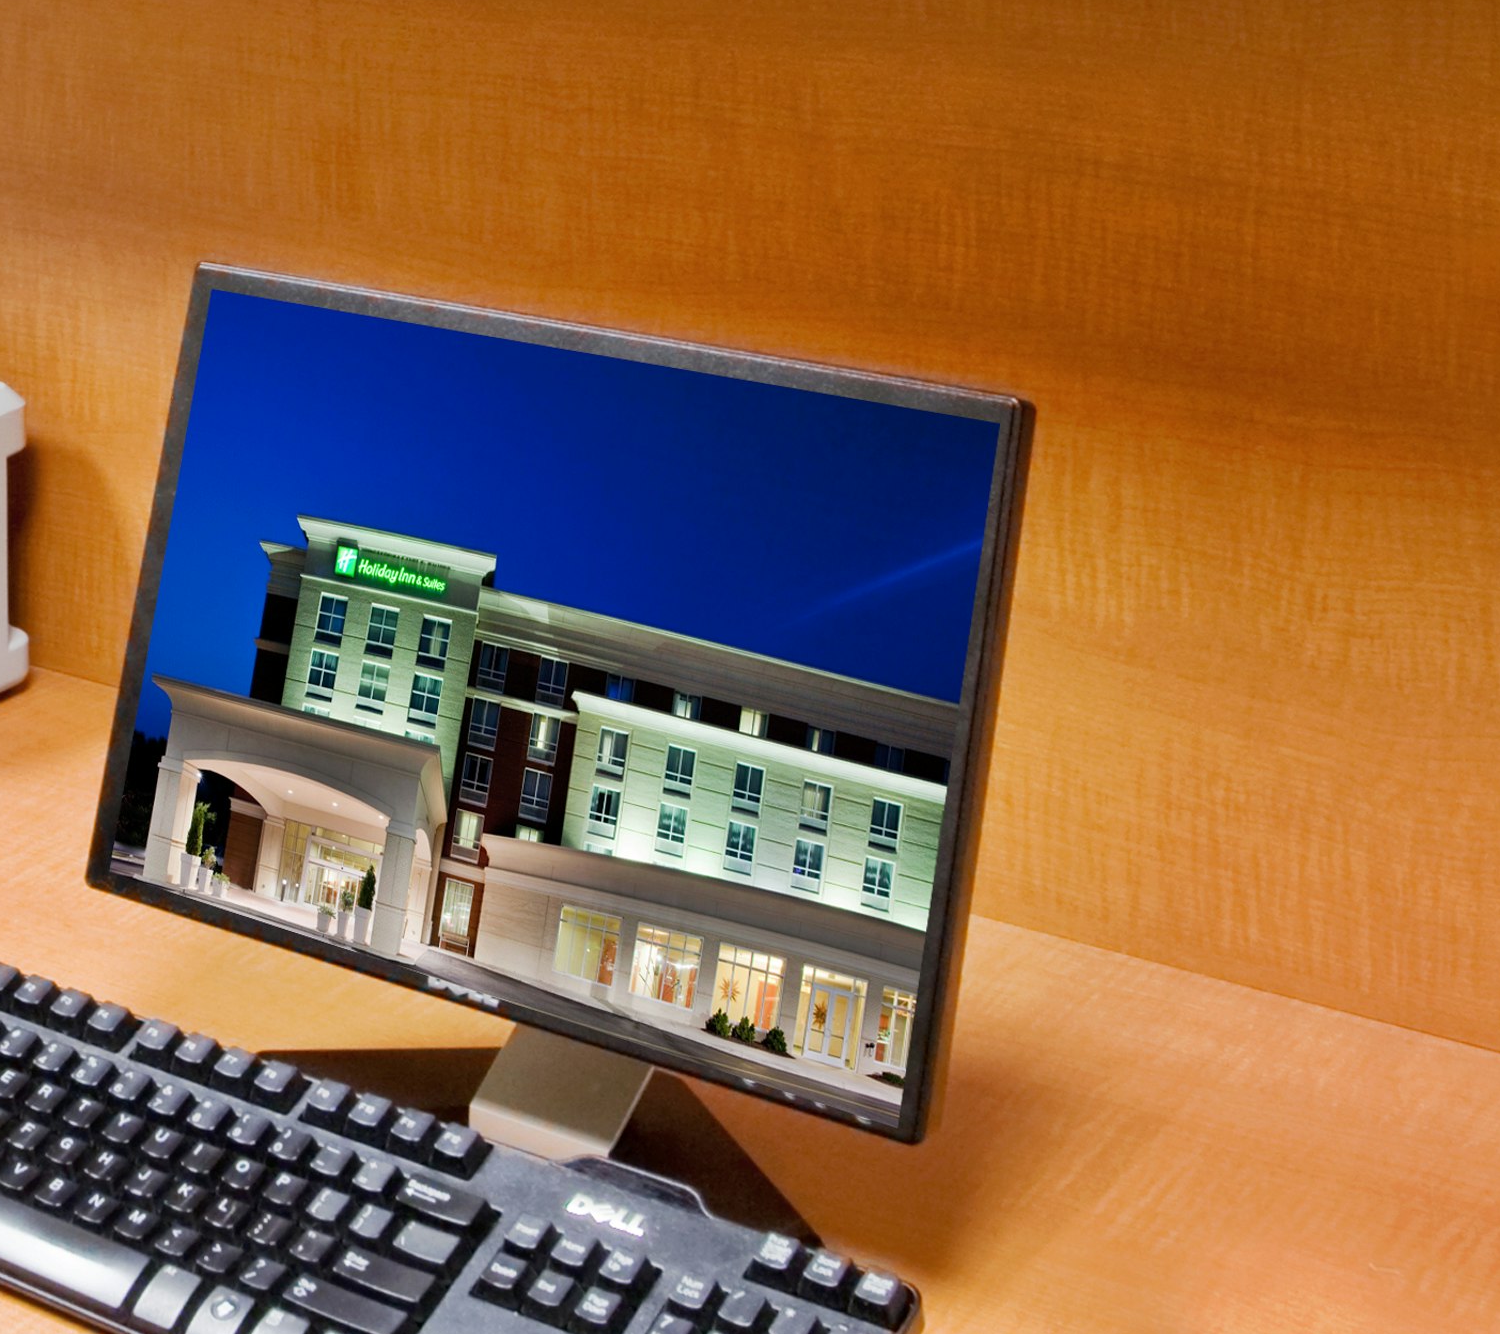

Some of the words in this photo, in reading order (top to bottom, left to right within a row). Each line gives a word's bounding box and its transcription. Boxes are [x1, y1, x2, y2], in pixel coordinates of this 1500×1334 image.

[358, 558, 399, 583] Holiday
[399, 567, 418, 584] Inn
[422, 576, 446, 592] Suites
[0, 1070, 15, 1084] E
[38, 1085, 52, 1098] R
[78, 1099, 92, 1112] T
[117, 1114, 131, 1127] Y
[155, 1130, 170, 1143] U
[236, 1160, 250, 1173] O
[276, 1173, 291, 1186] P
[565, 1193, 645, 1237] DELL
